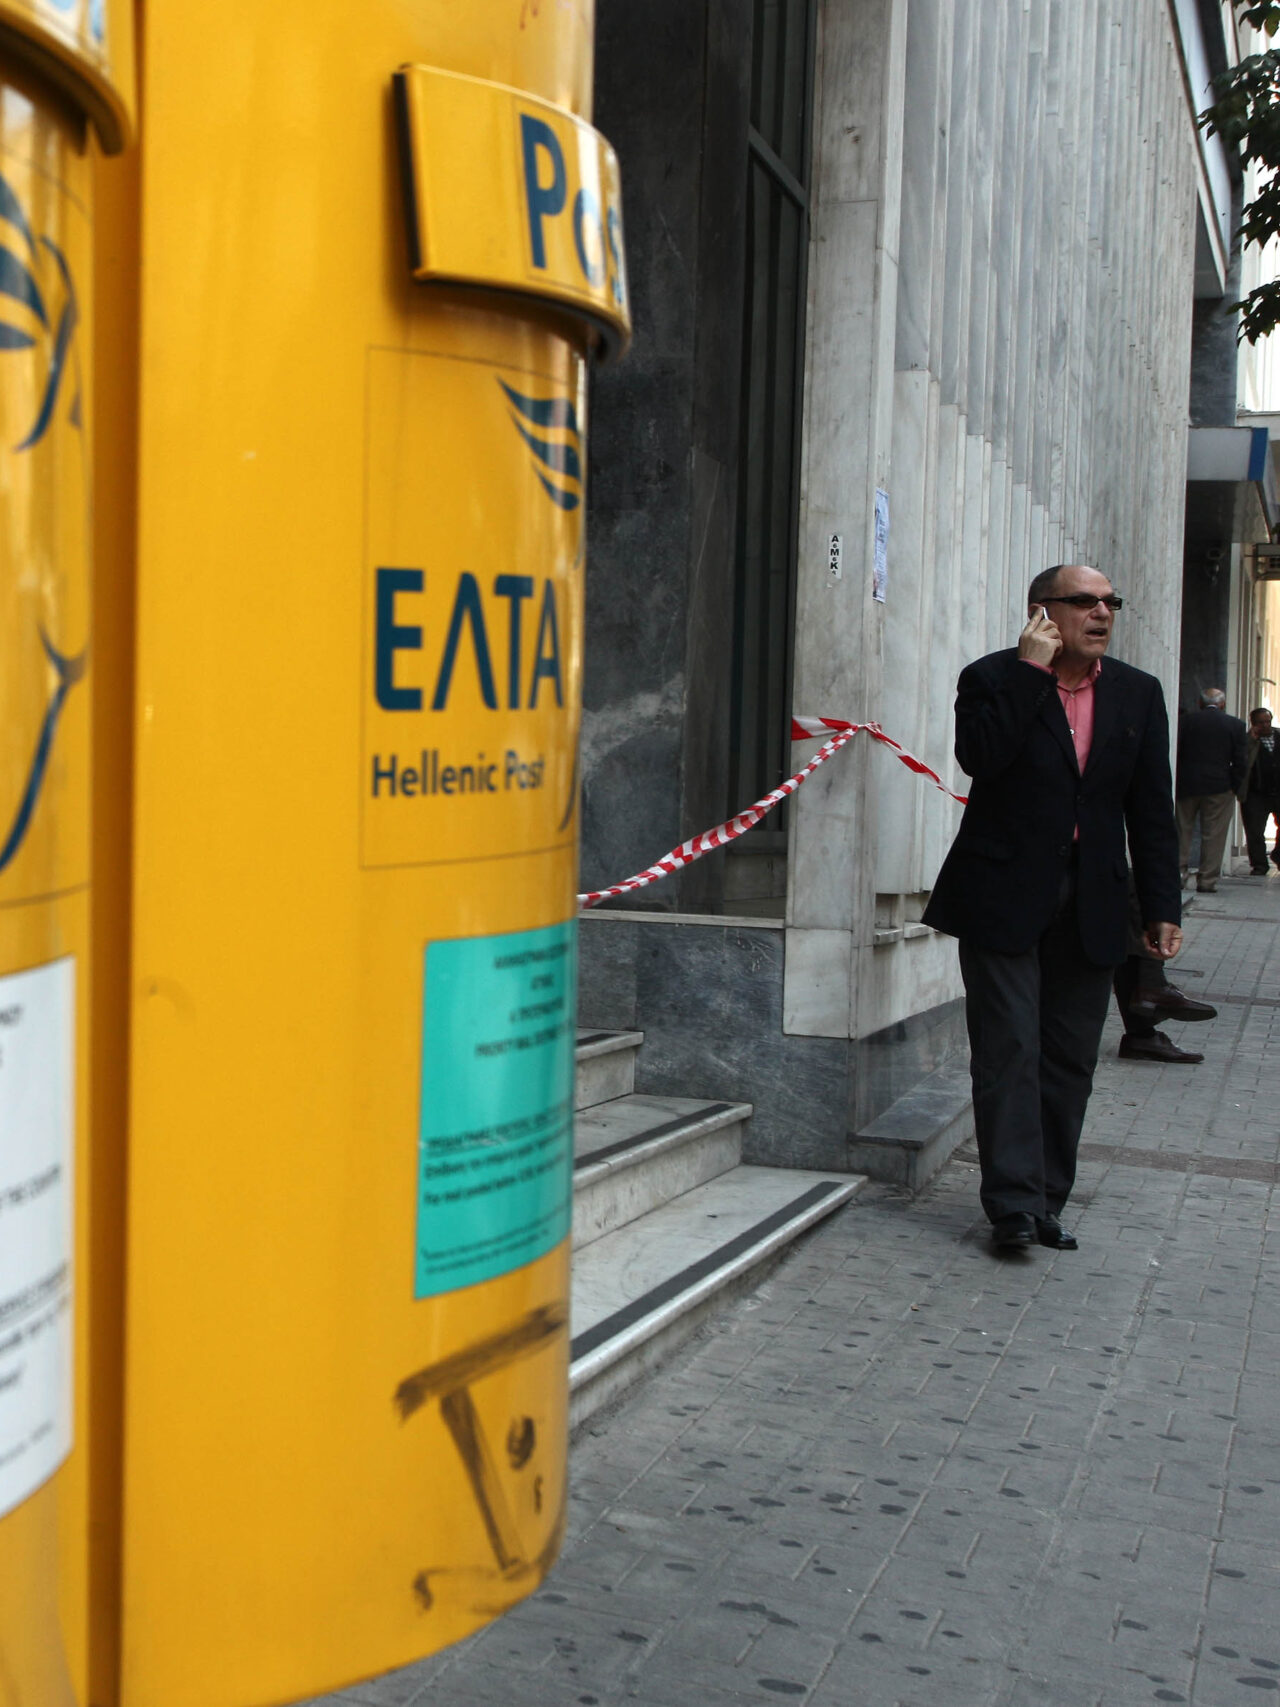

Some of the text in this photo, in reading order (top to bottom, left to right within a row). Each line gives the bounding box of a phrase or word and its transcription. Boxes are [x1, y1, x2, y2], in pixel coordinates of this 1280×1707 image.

[375, 567, 564, 712] ΕΛΤΑ
[372, 749, 544, 798] Hellenic Post
